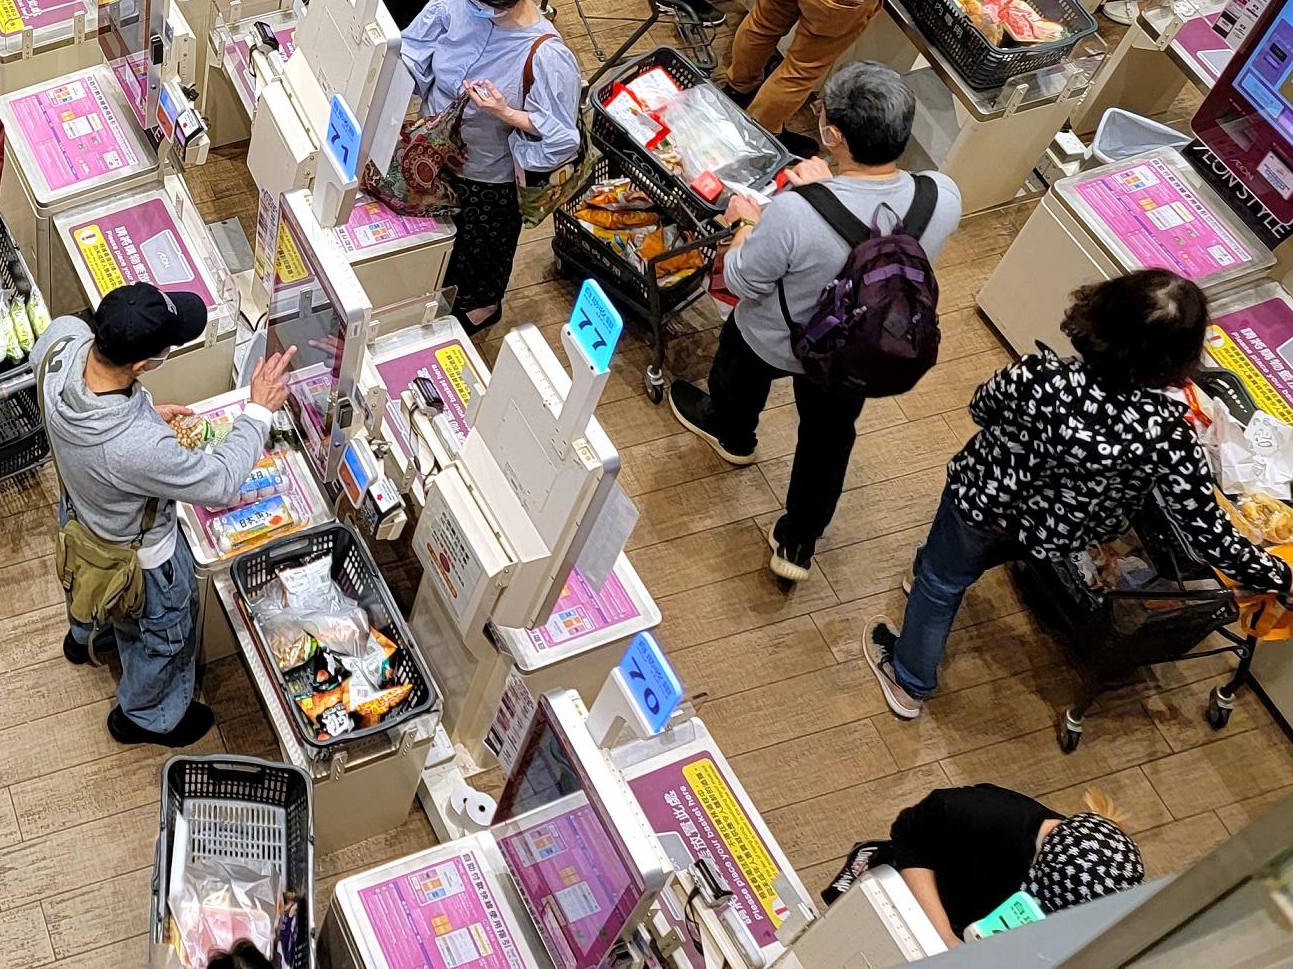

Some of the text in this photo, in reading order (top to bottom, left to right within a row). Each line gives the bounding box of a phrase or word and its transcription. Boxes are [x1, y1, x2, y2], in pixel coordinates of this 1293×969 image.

[330, 124, 349, 166] 71
[1235, 183, 1290, 240] STYLE
[578, 307, 607, 350] 77
[1230, 331, 1253, 355] Please
[1250, 354, 1269, 373] place
[1265, 372, 1285, 390] your
[629, 656, 660, 715] 70
[680, 785, 763, 920] Please place your basket here
